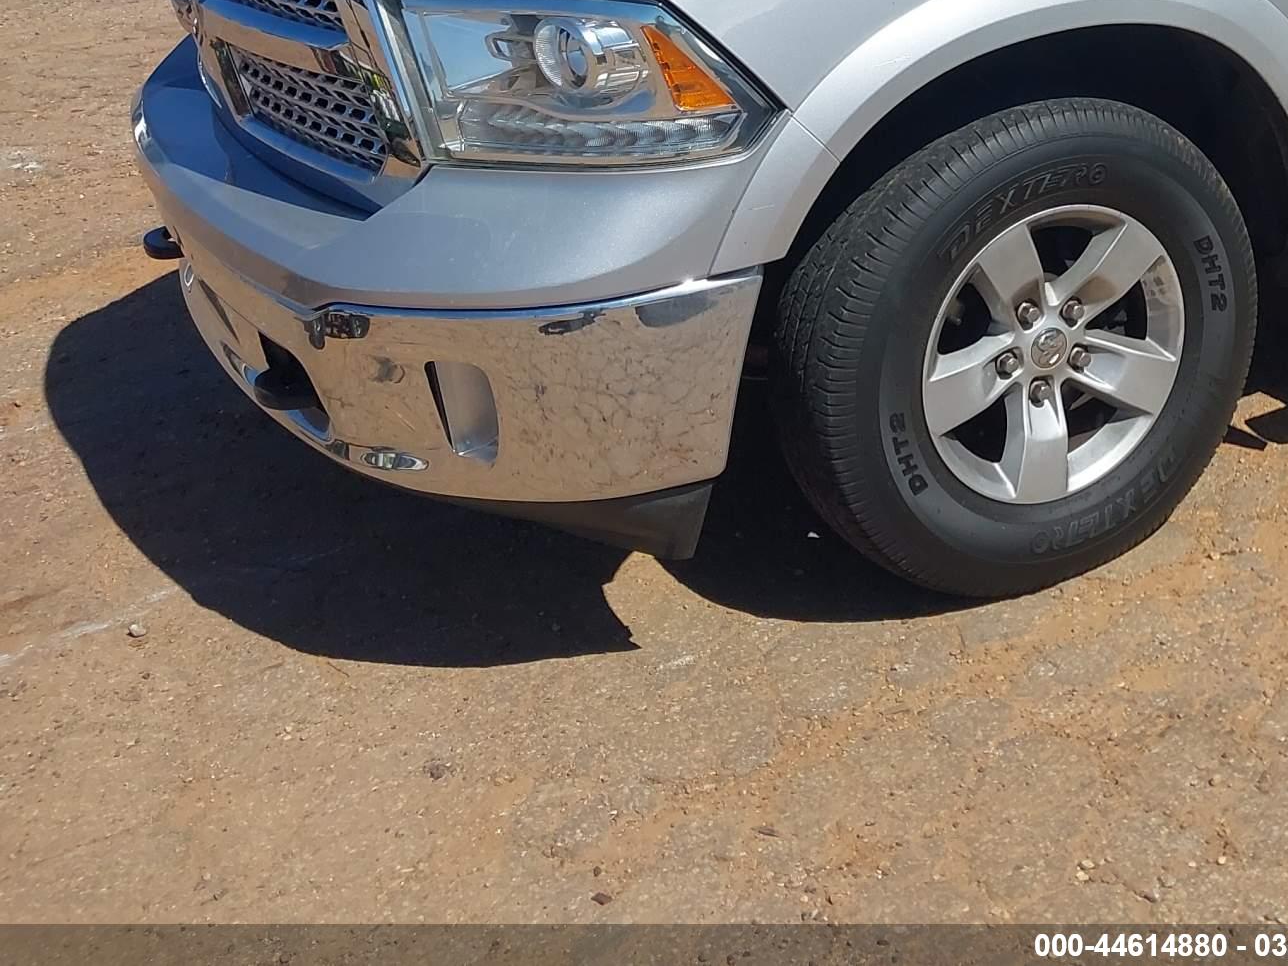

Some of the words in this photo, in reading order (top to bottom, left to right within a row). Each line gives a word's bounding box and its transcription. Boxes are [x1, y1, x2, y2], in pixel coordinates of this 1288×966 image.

[938, 162, 1107, 260] DEXTERO
[1193, 236, 1227, 312] DHT2
[889, 413, 929, 496] DHT2
